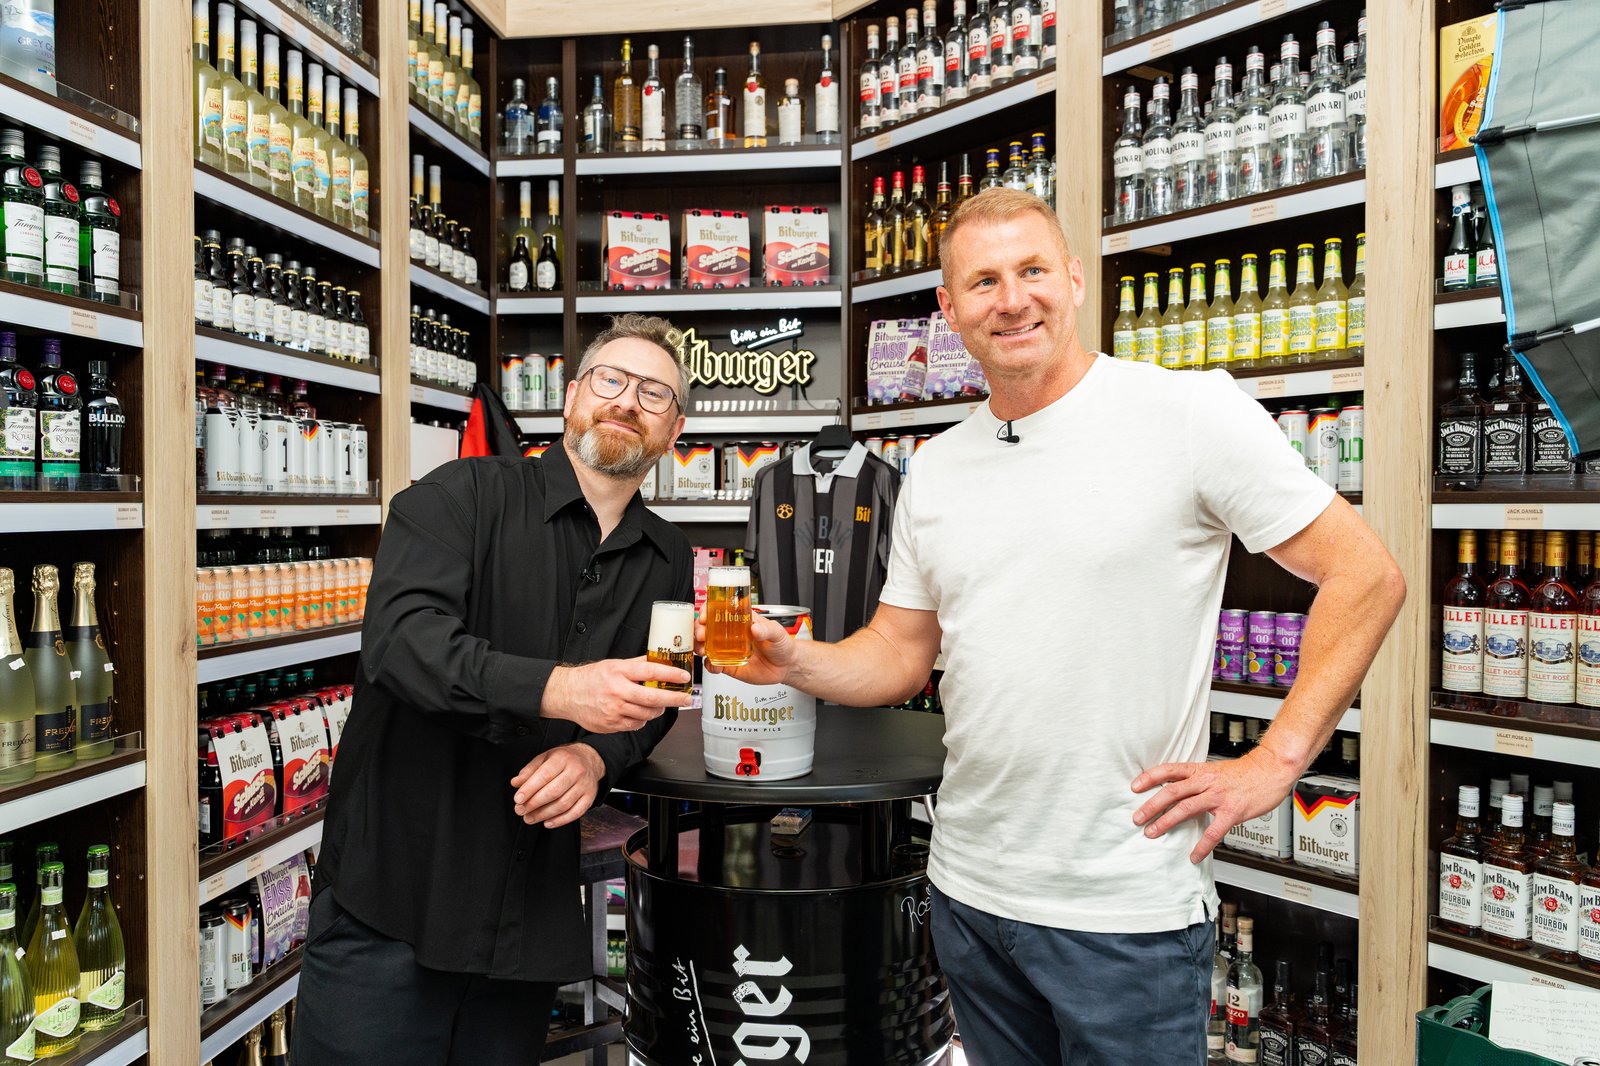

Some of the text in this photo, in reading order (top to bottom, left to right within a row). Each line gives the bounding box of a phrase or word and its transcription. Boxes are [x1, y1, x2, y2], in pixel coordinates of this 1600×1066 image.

[1457, 34, 1481, 46] Dimple
[1458, 42, 1481, 53] Golden
[1455, 47, 1485, 60] Selection
[620, 230, 659, 245] Bitburger
[699, 229, 738, 242] Bitburger
[778, 225, 818, 239] Bitburger
[730, 318, 802, 345] Bitte ein Bit
[874, 331, 907, 342] Bitburger
[873, 341, 907, 361] FASS
[929, 349, 967, 363] Brause
[869, 356, 906, 371] Brause
[1440, 423, 1478, 438] JACK DANIEL'S
[1484, 420, 1523, 436] JACK DANIEL'S
[1533, 420, 1548, 433] JACK
[677, 477, 712, 491] Bitburger
[855, 505, 872, 523] Bit
[1529, 615, 1575, 630] LILLET
[1503, 667, 1521, 676] ROSÉ
[1552, 673, 1570, 681] ROSÉ
[713, 693, 794, 725] Bitburger
[290, 734, 319, 752] Bitburger
[229, 753, 263, 773] Bitburger
[1299, 834, 1350, 862] Bitburger
[261, 866, 289, 887] Bitburger
[1440, 861, 1476, 883] JIM BEAM
[1483, 872, 1520, 894] JIM BEAM
[264, 876, 293, 911] FASS
[1441, 890, 1471, 907] BOURBON
[1533, 883, 1573, 905] JIM BEAM
[1579, 894, 1593, 908] JIM
[266, 901, 294, 926] Brause
[1483, 903, 1515, 919] BOURBON
[1534, 914, 1568, 931] BOURBON
[672, 957, 692, 1001] Bit
[1541, 978, 1556, 987] BEAM
[1227, 992, 1240, 1007] 12
